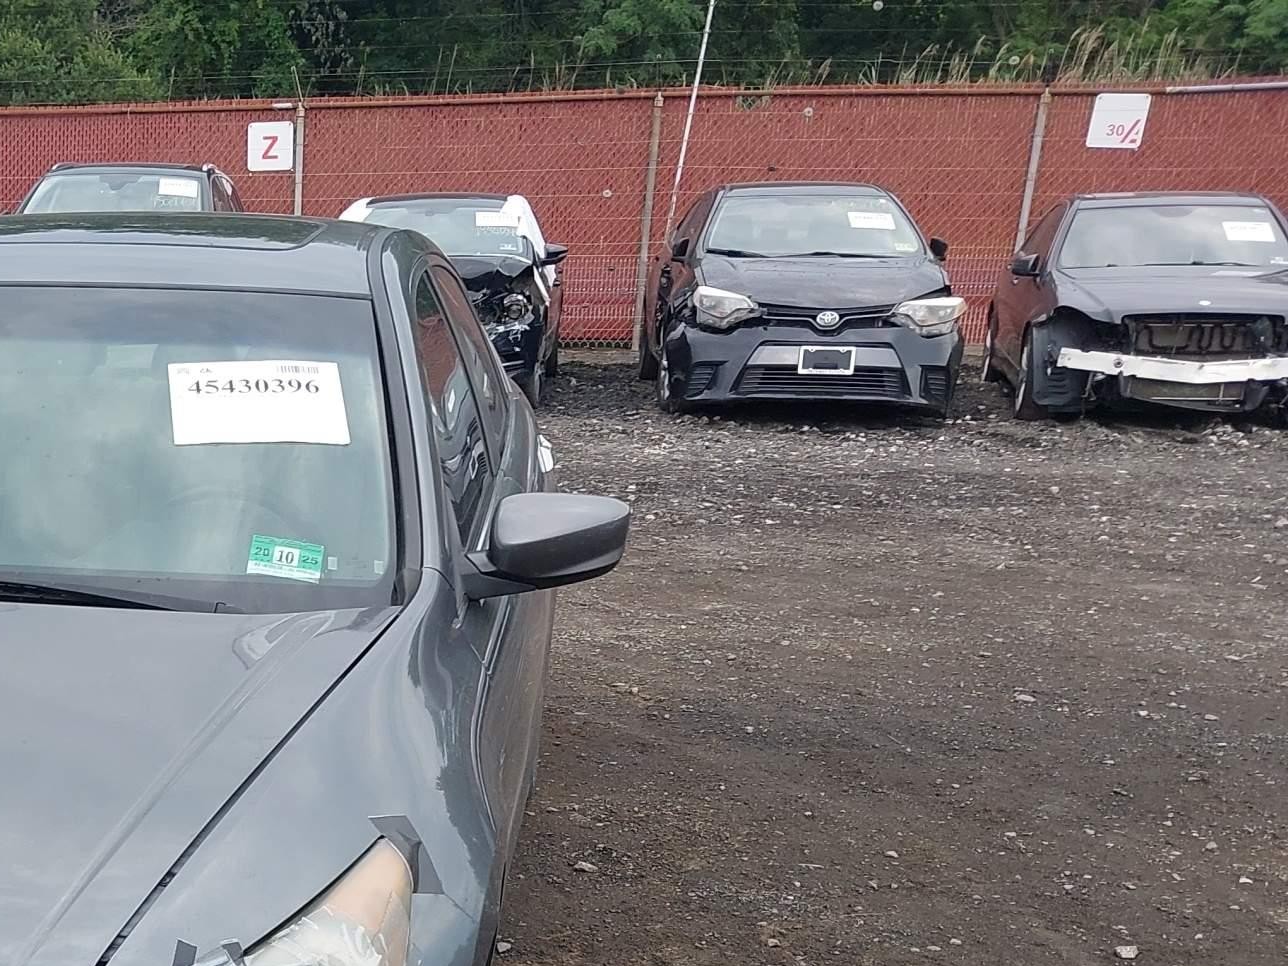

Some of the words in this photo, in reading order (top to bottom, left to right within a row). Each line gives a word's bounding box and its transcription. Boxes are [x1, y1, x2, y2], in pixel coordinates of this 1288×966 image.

[262, 136, 278, 159] Z
[187, 379, 320, 394] 45430396
[255, 547, 270, 557] 20
[277, 550, 295, 565] 10
[302, 555, 318, 565] 25
